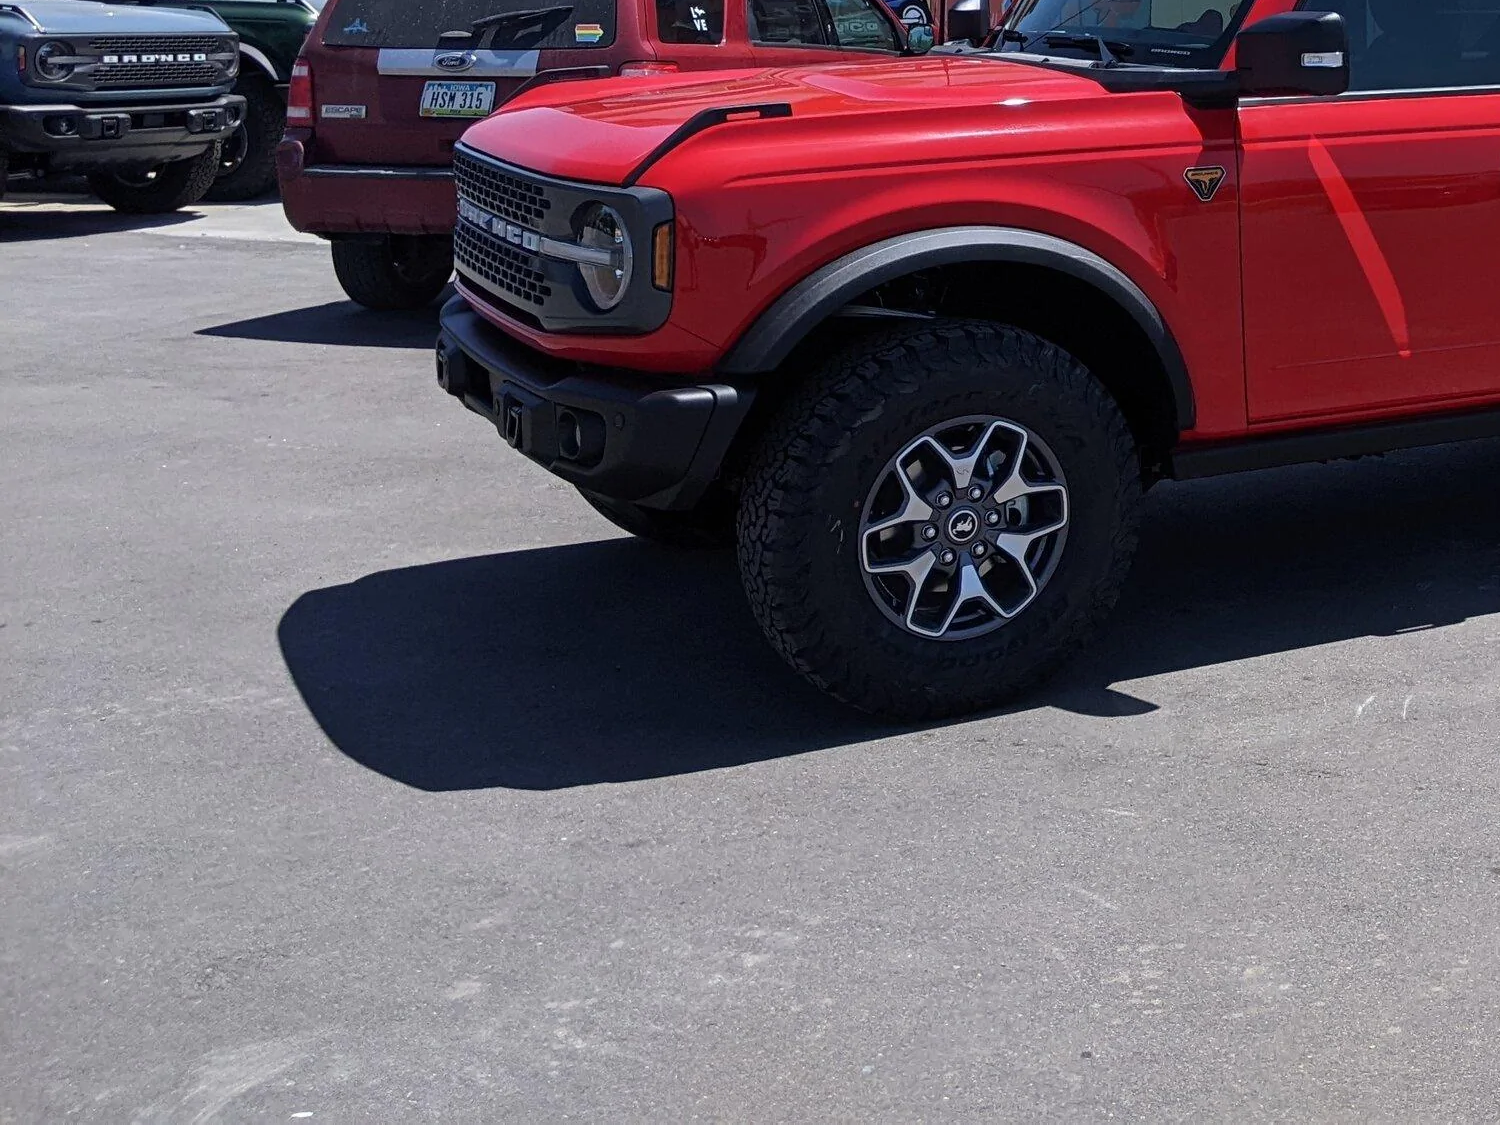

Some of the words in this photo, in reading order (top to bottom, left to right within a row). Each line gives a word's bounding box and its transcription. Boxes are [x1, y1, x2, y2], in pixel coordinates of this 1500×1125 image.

[103, 53, 206, 63] BRONCO
[430, 91, 456, 109] HSM
[459, 91, 483, 109] 315
